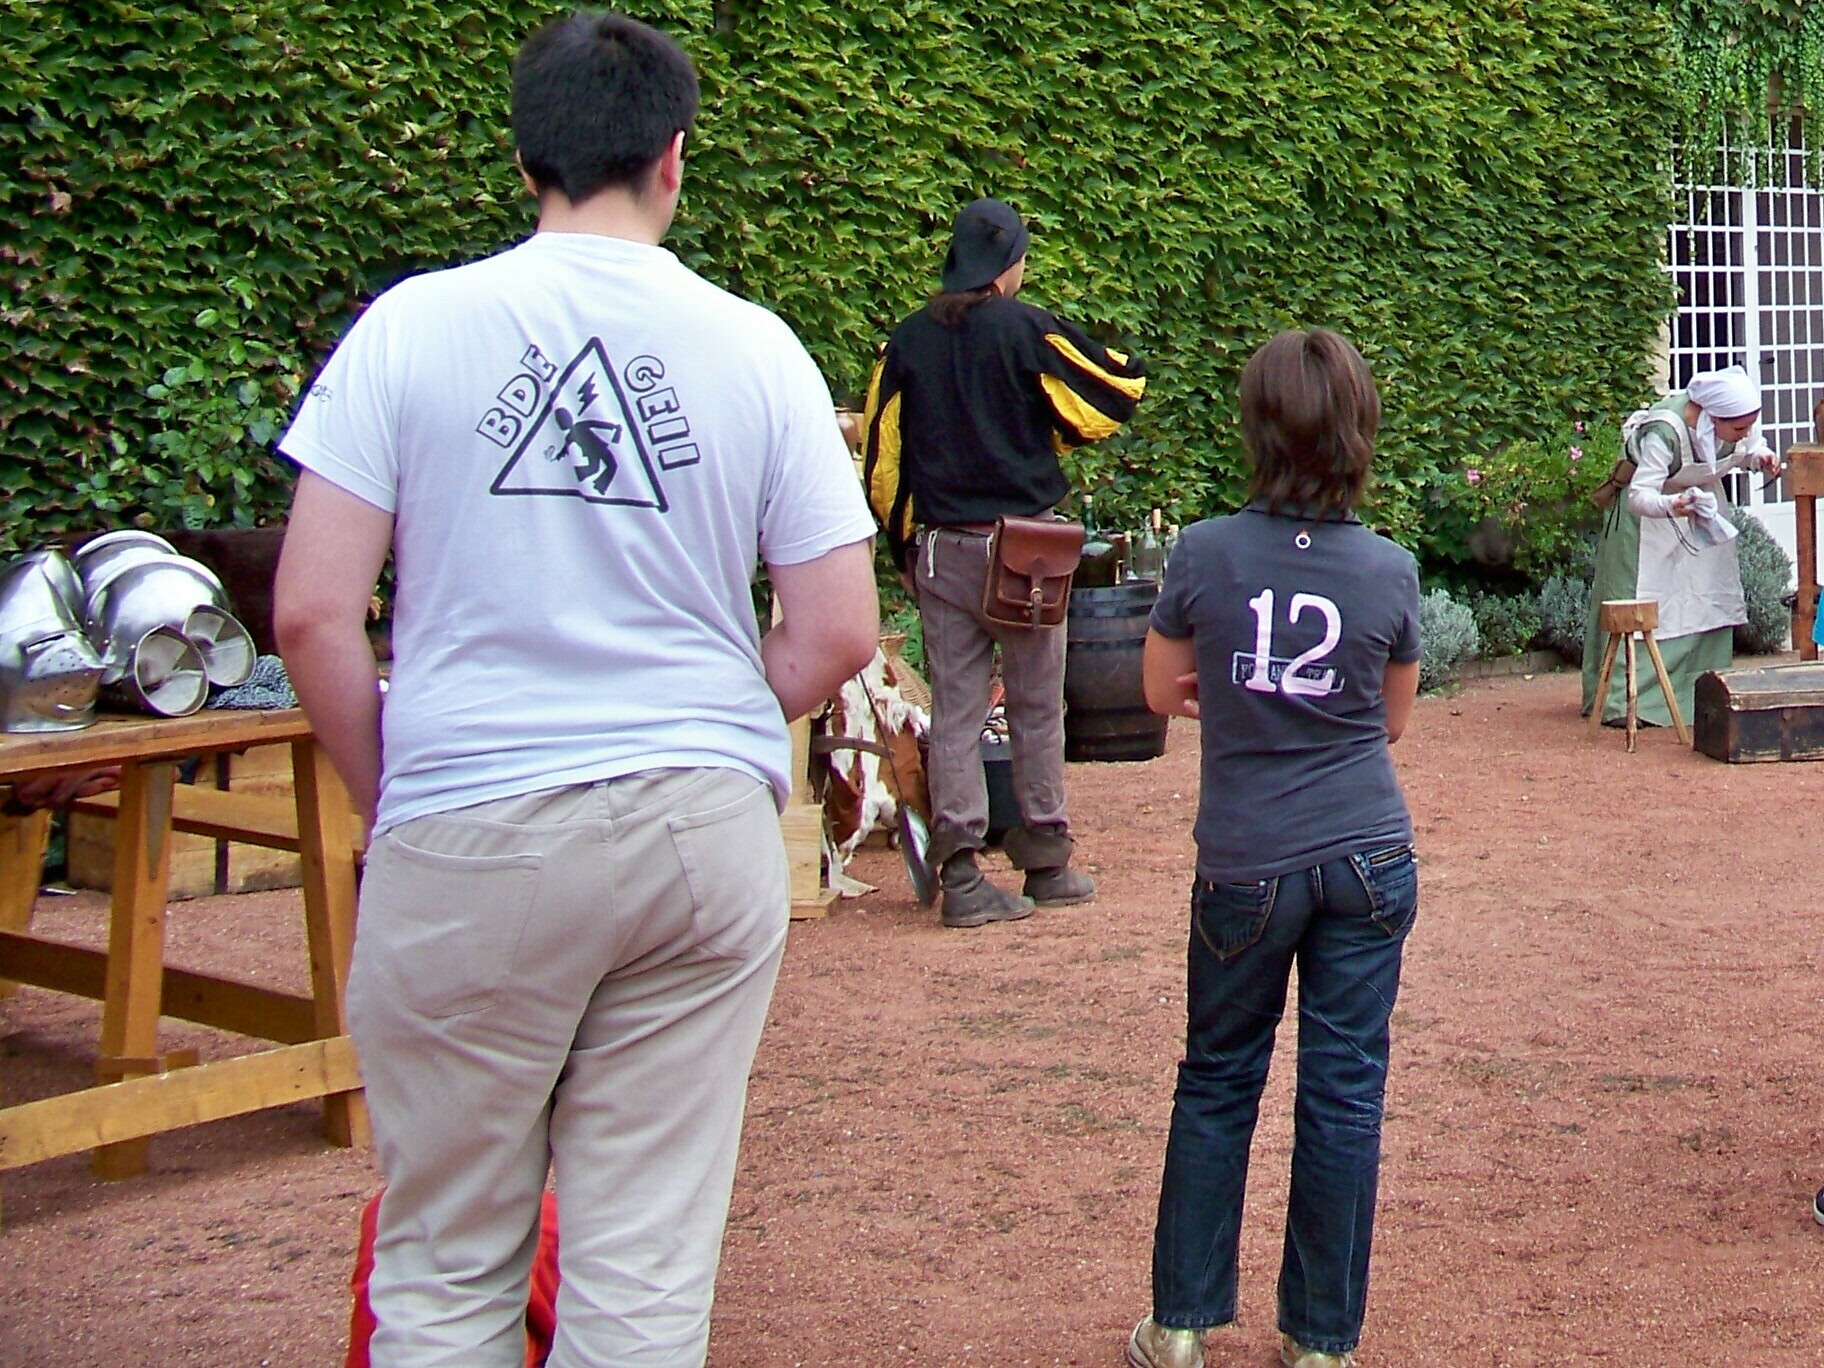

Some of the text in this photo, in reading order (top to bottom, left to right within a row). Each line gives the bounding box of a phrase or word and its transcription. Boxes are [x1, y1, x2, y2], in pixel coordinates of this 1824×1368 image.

[476, 344, 558, 449] BDE
[624, 354, 700, 471] GEII
[1245, 588, 1342, 697] 12
